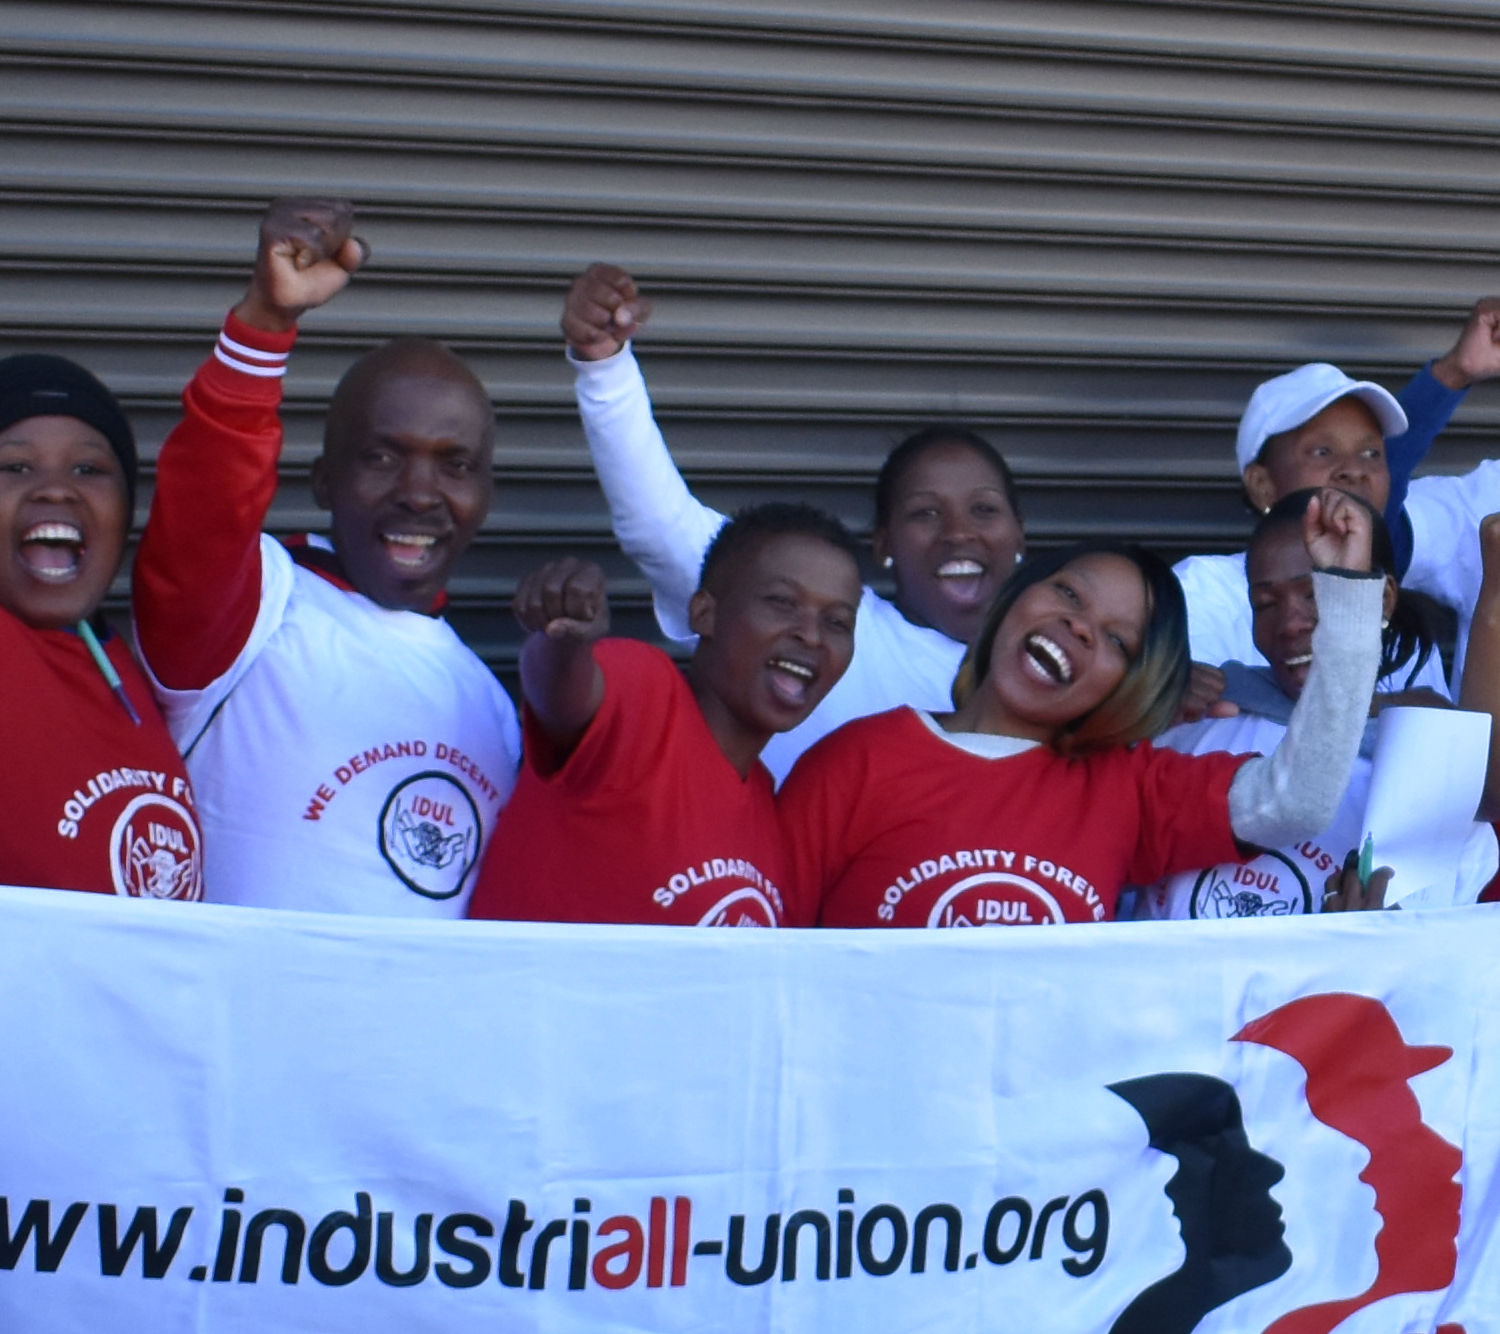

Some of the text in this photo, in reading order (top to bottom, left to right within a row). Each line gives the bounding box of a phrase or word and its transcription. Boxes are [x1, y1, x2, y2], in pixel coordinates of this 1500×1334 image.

[303, 740, 499, 821] WE DEMAND DECENT
[57, 766, 166, 840] SOLIDARITY
[411, 795, 455, 826] IDUL
[148, 820, 190, 854] IDUL
[877, 848, 1106, 922] SOLIDARITY FOREVE
[1233, 866, 1281, 894] IDUL
[976, 898, 1034, 923] IDUL
